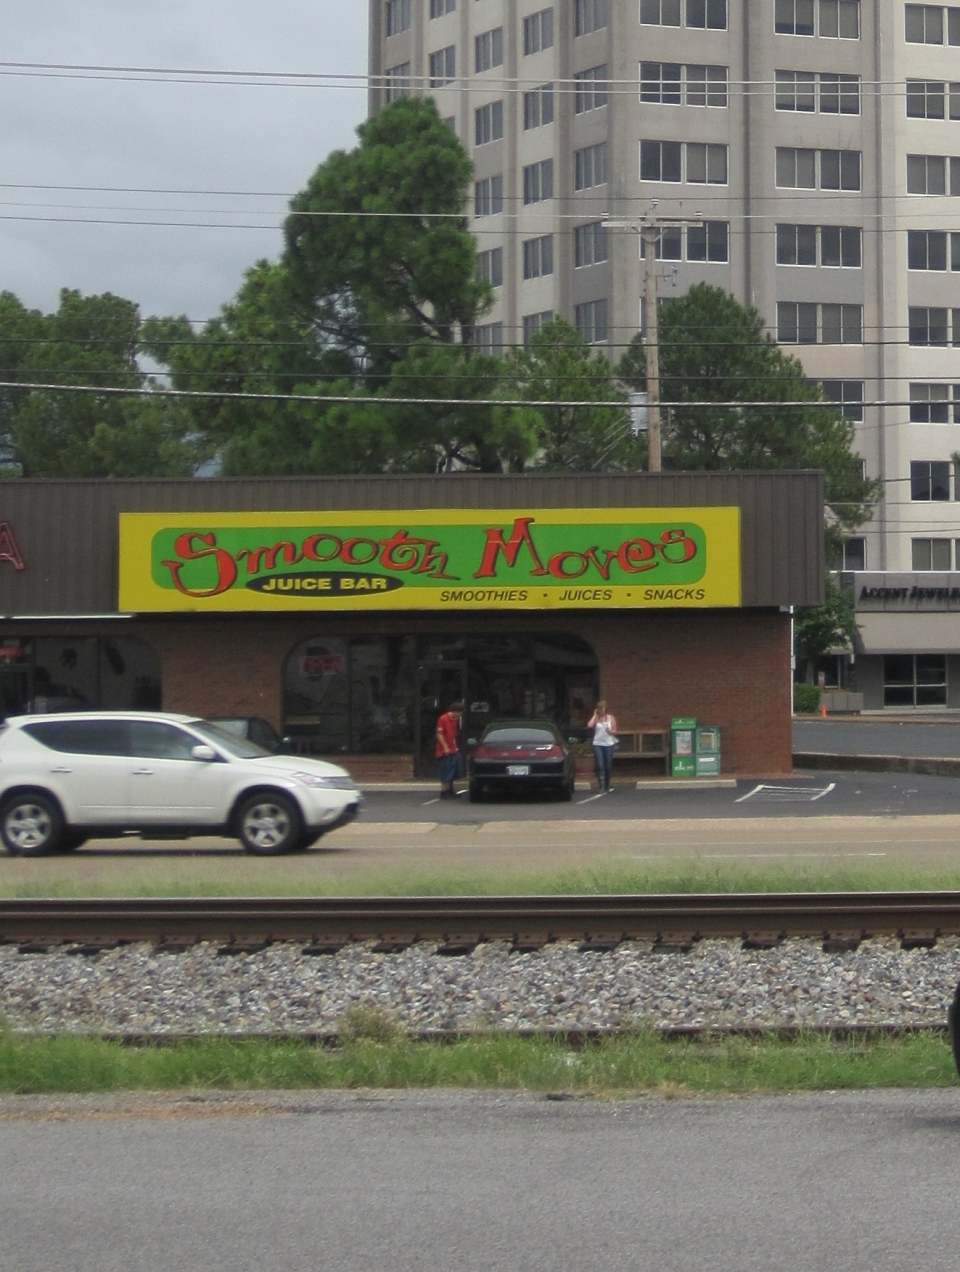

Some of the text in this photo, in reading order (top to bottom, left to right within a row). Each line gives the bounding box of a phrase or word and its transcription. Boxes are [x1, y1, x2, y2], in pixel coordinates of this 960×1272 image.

[161, 516, 697, 598] Smooth Moves
[262, 577, 388, 591] JUICE BAR
[440, 588, 706, 602] SMOOTHIES JUICES SNACKS
[860, 585, 909, 599] ACCENT
